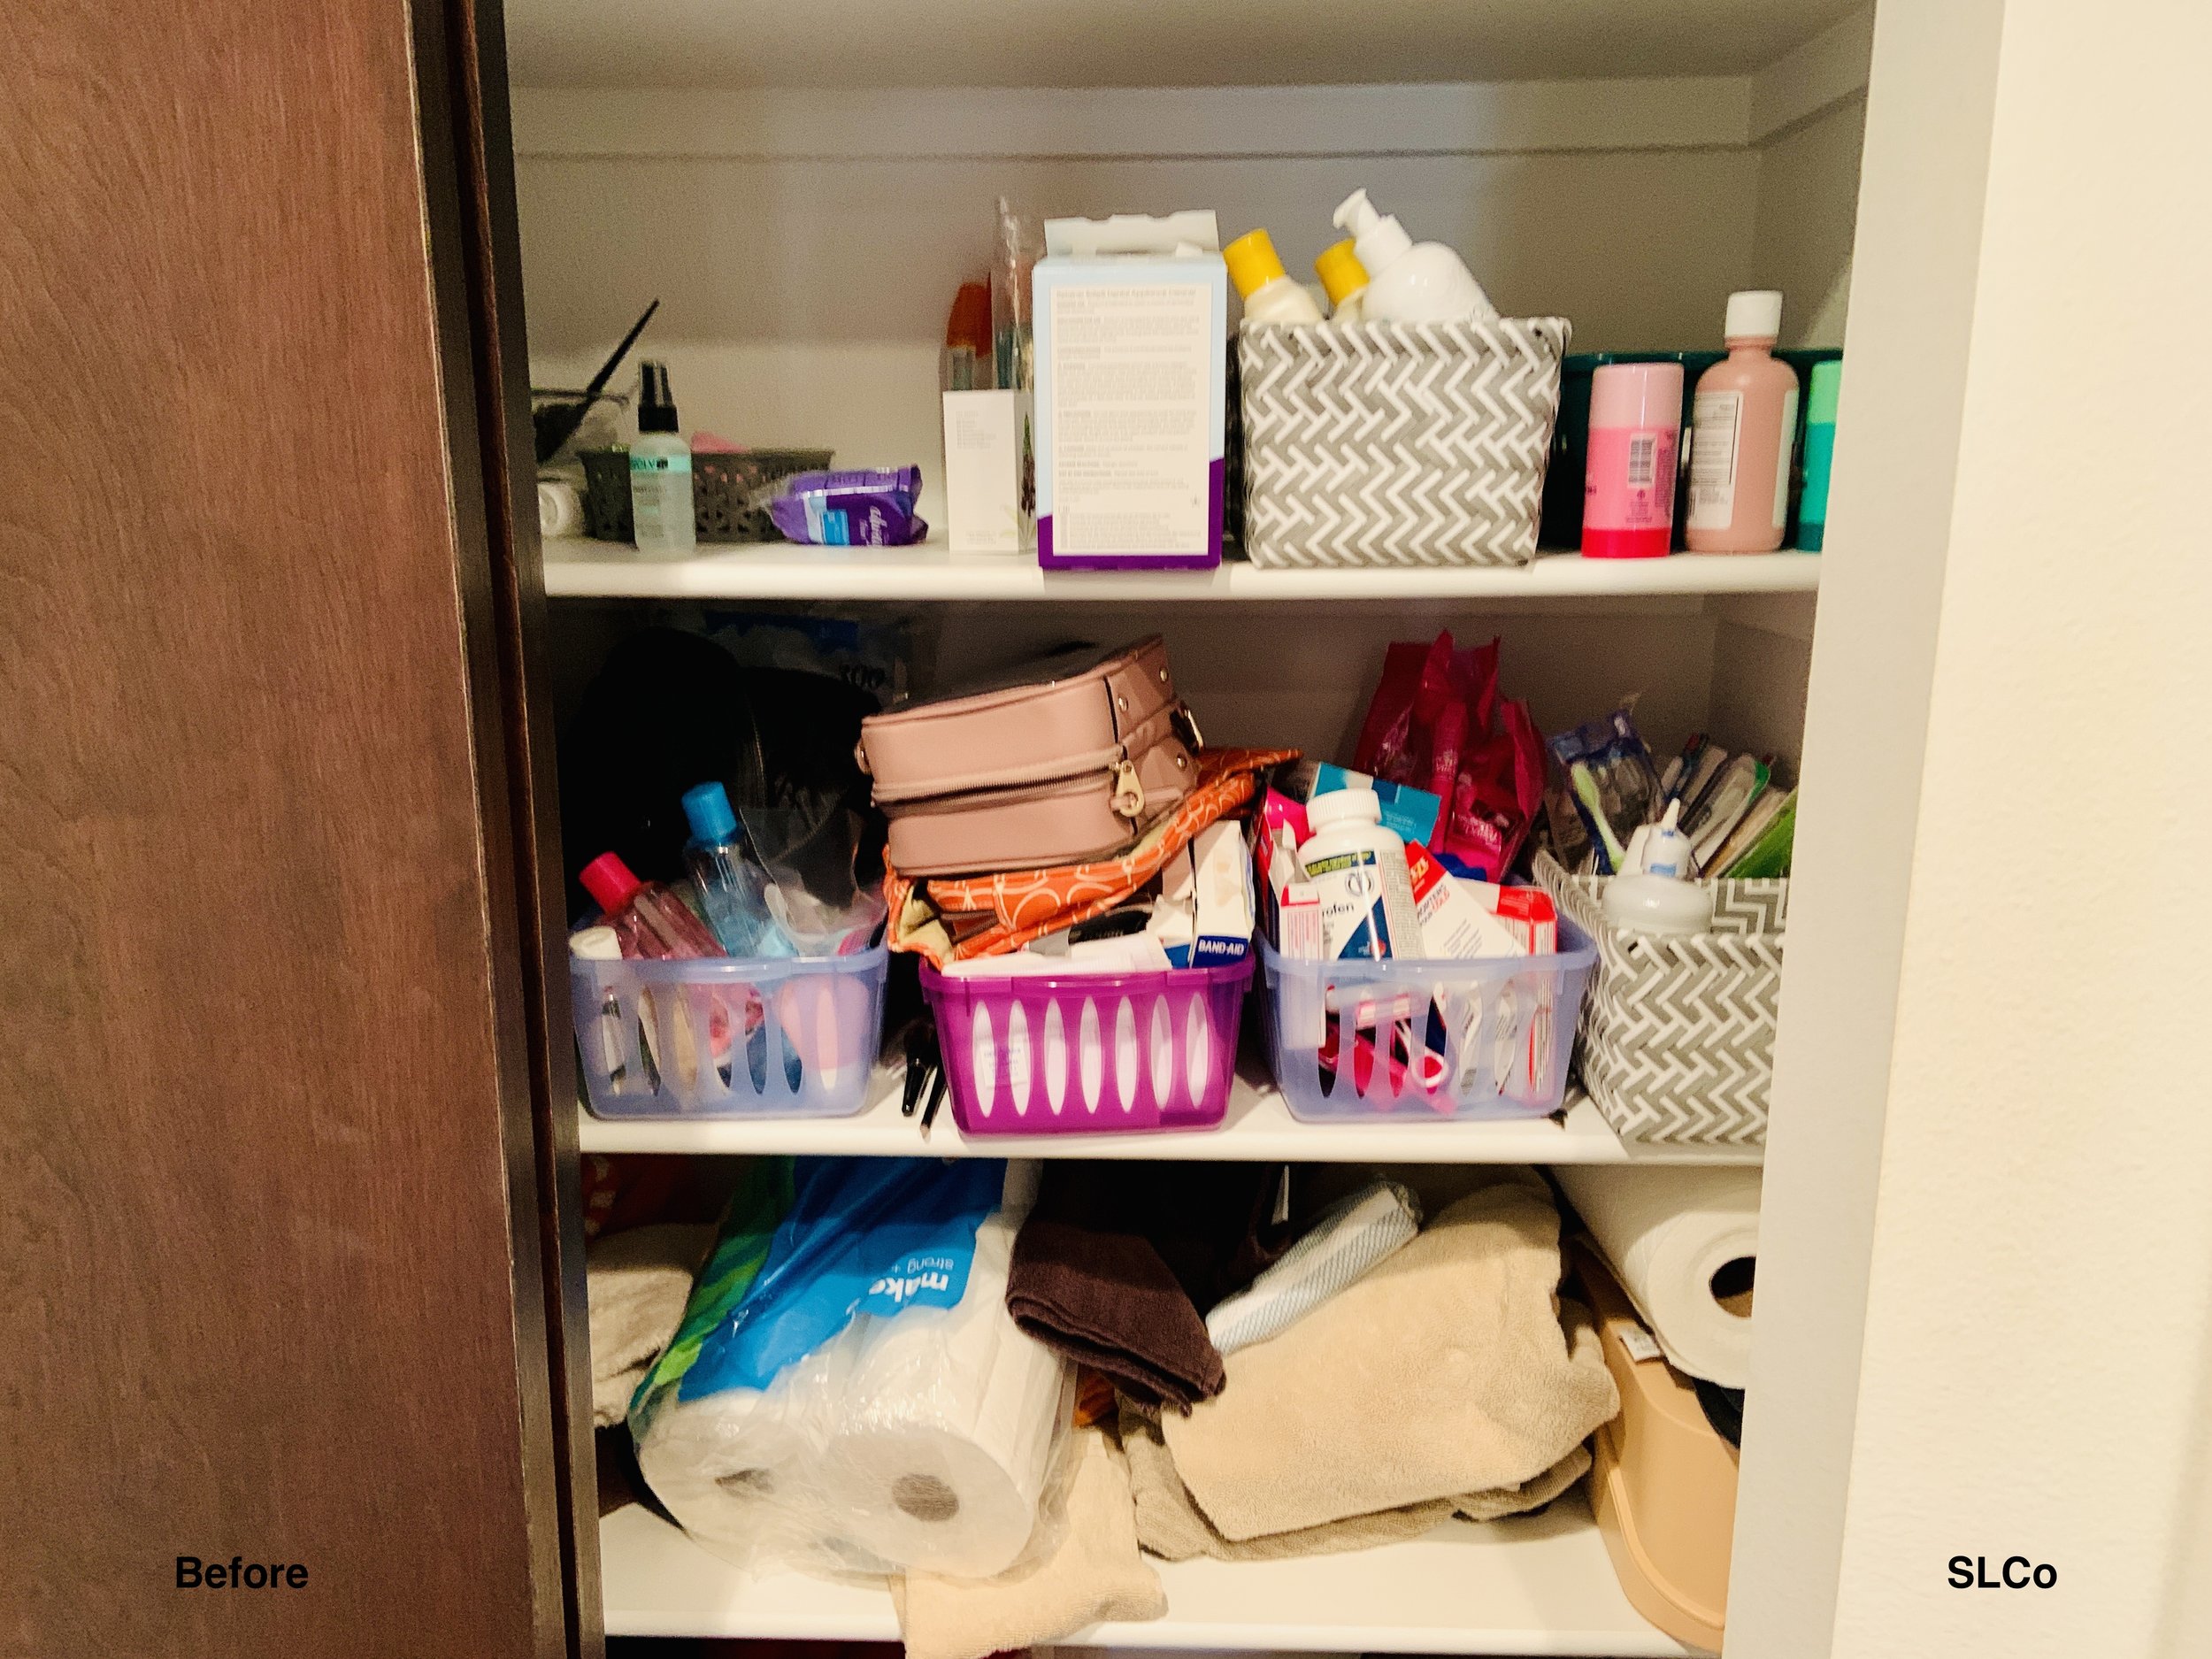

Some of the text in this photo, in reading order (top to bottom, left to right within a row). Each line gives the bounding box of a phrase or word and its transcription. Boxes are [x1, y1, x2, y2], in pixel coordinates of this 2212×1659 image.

[1198, 939, 1245, 956] BAND-AID
[907, 1256, 955, 1274] strong
[868, 1271, 949, 1303] make
